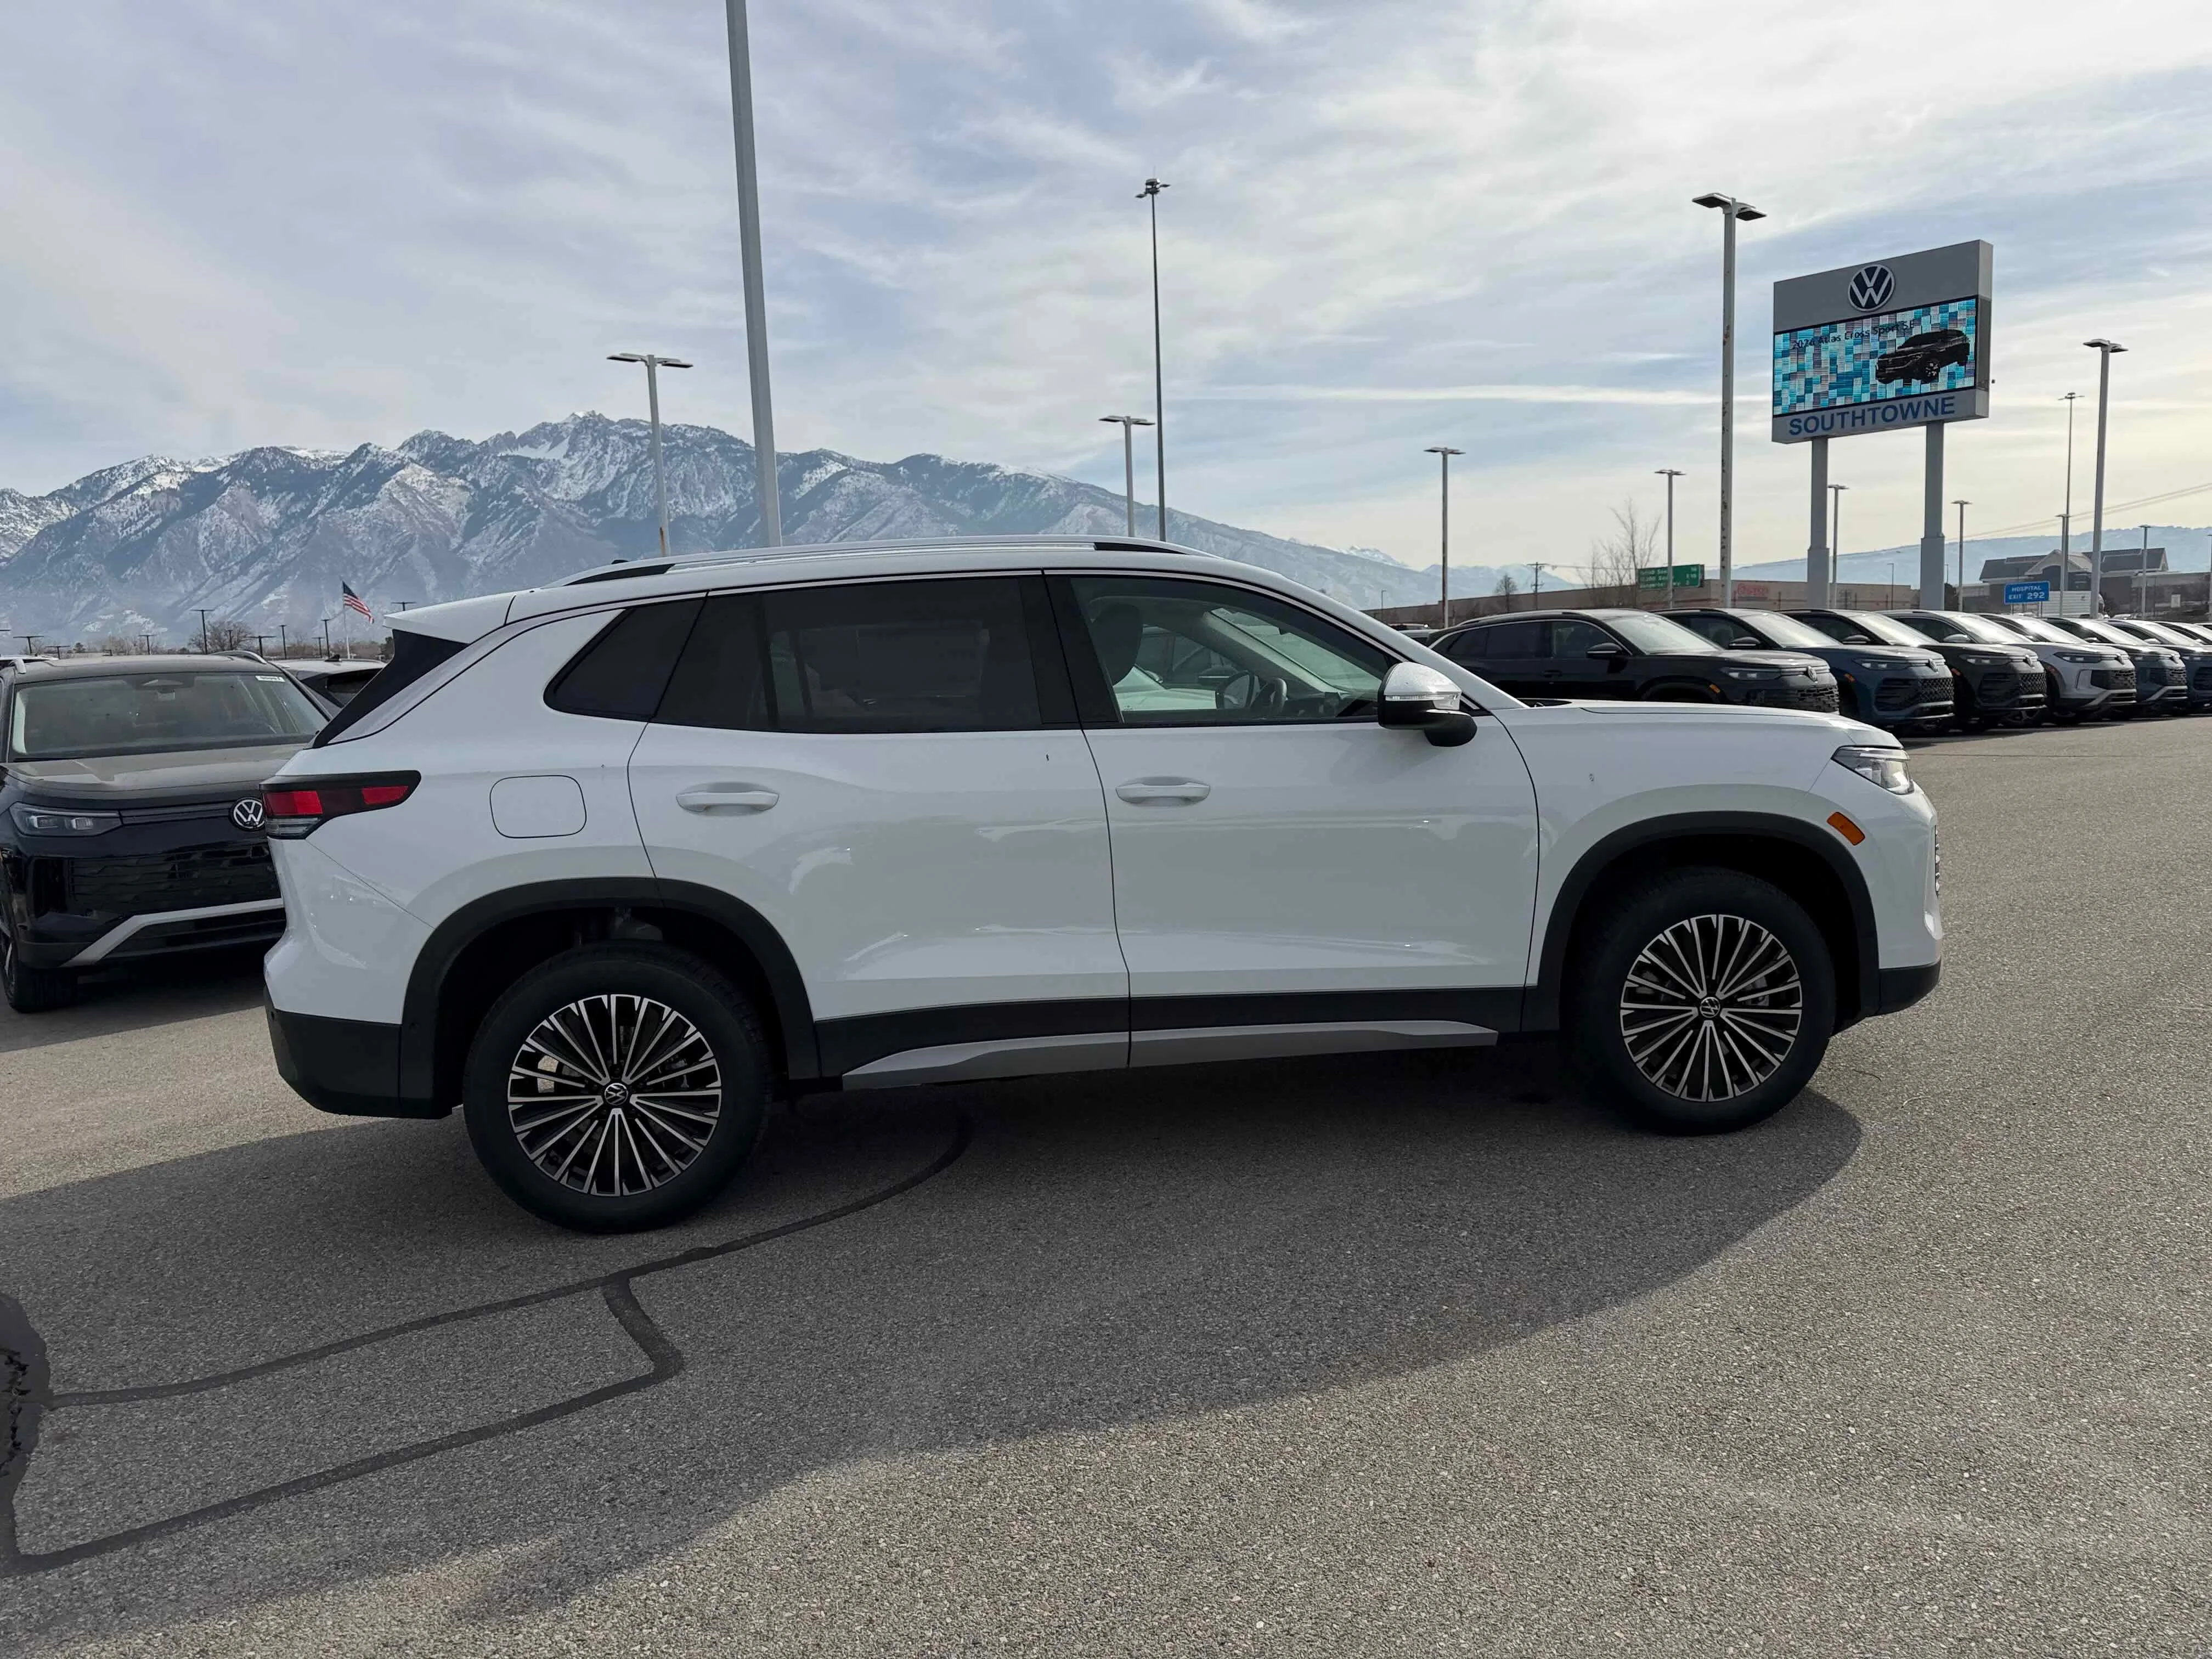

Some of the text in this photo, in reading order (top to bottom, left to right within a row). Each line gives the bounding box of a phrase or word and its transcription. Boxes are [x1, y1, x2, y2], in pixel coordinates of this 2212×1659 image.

[1848, 264, 1895, 312] VW
[1844, 330, 1870, 340] Cross
[1789, 396, 1955, 436] SOUTHTOWNE
